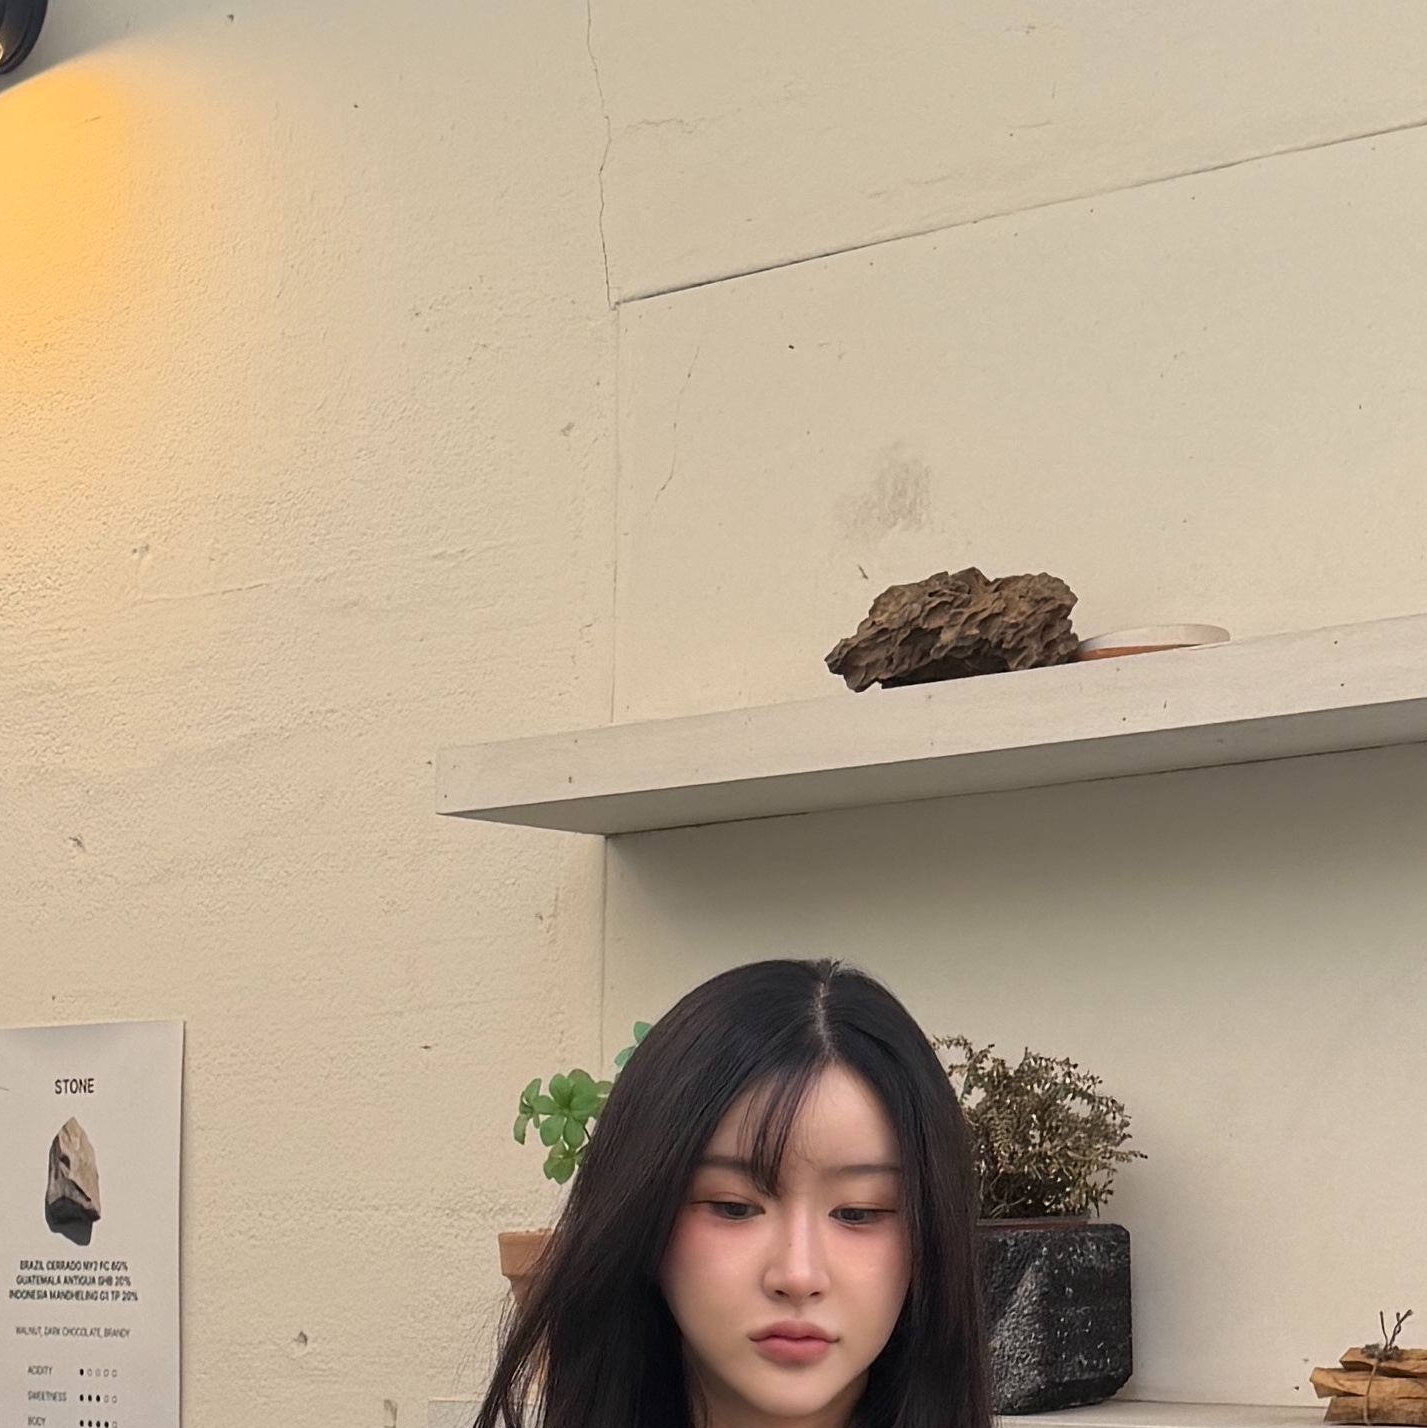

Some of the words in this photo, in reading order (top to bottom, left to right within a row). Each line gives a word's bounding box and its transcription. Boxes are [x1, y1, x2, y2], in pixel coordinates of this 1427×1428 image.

[54, 1077, 95, 1095] STONE
[19, 1259, 44, 1271] BRAZIL
[46, 1259, 82, 1272] CERRADO
[15, 1274, 62, 1286] GUATEMALA
[63, 1274, 96, 1287] ANTIGUA
[114, 1275, 132, 1287] 20%
[8, 1289, 48, 1300] INDONESIA
[122, 1290, 139, 1302] 20%
[27, 1365, 53, 1376] ACIDITY
[27, 1390, 68, 1403] SWEETNESS
[27, 1416, 46, 1427] BODY
